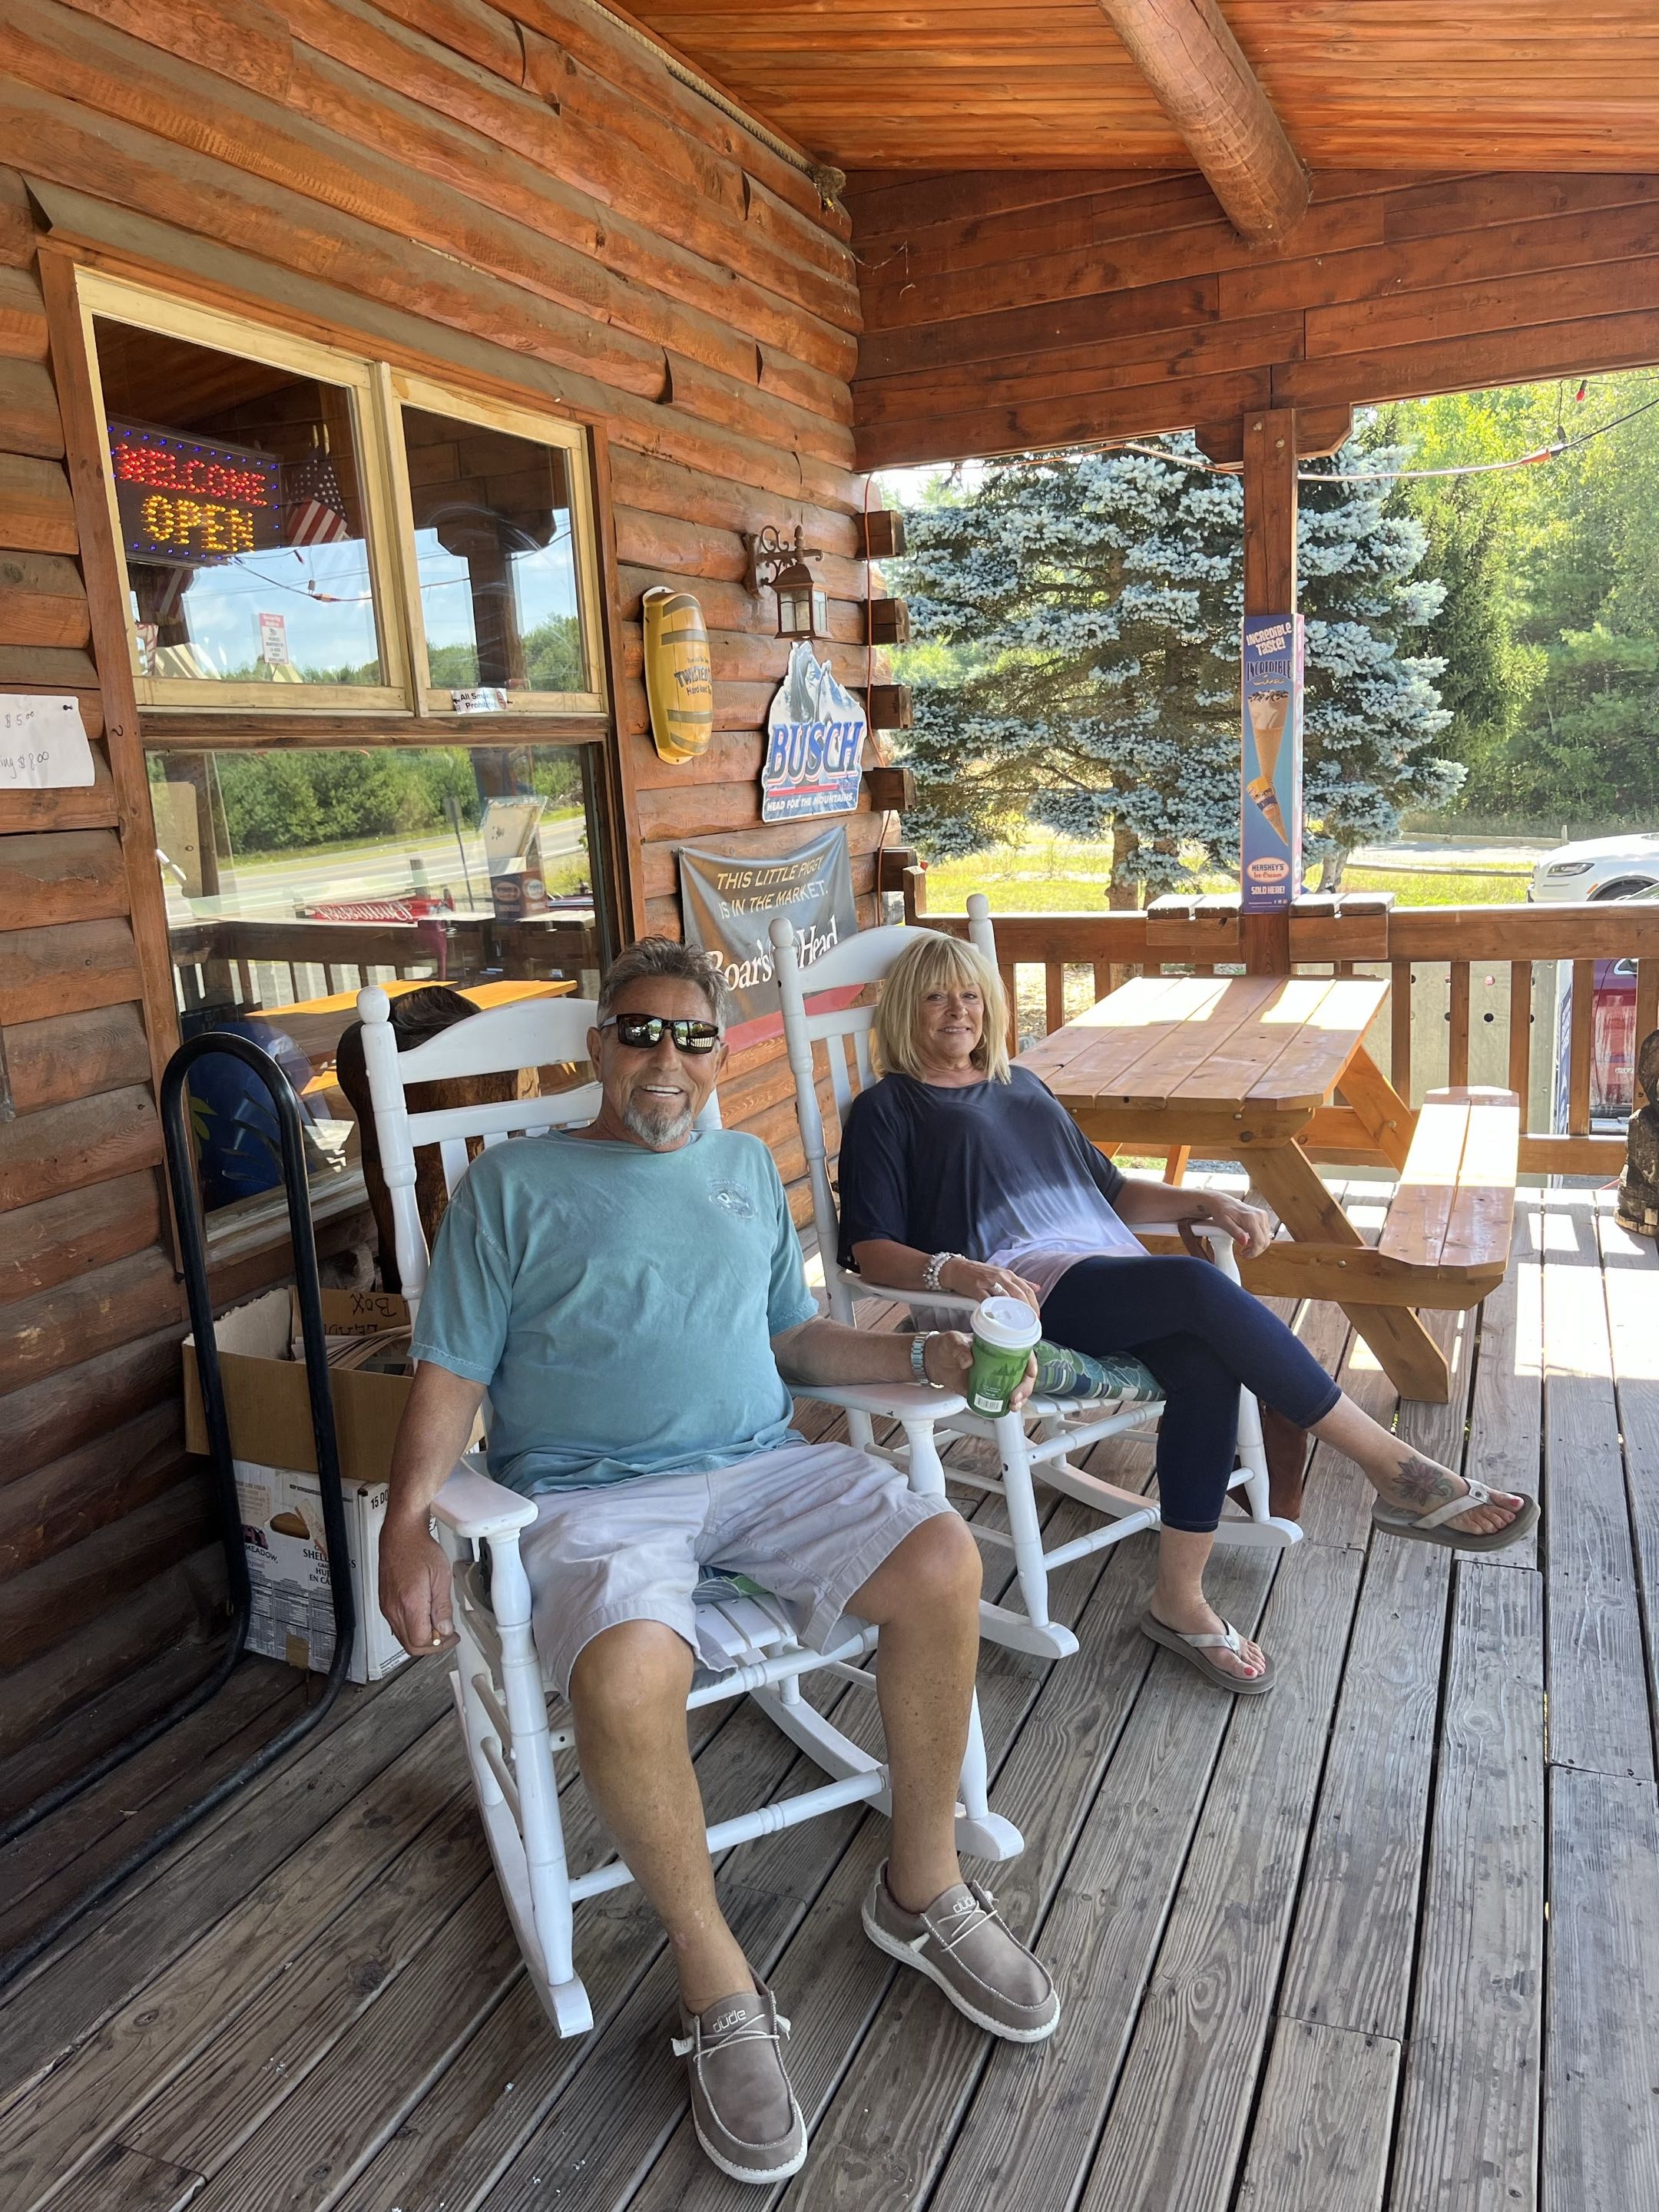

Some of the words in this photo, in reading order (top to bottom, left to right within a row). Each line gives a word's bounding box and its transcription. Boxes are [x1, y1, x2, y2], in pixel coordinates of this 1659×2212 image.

[118, 443, 267, 506] WELCOME
[143, 495, 253, 554] OPEN
[1247, 660, 1291, 682] INCREDIBLE
[768, 721, 864, 780] BUSCH
[767, 800, 785, 812] HEAD
[786, 798, 799, 809] FOR
[800, 796, 812, 806] THE
[813, 792, 853, 805] MOUNTAINS
[717, 872, 753, 890] THIS
[755, 864, 796, 887] LITTLE
[797, 853, 825, 879] PIGGY
[718, 901, 730, 920] IS
[731, 898, 747, 917] IN
[750, 893, 776, 913] THE
[776, 879, 829, 908] MARKET.
[1251, 886, 1267, 895] SOLD
[796, 915, 838, 969] Head
[371, 1496, 379, 1509] 15
[713, 2009, 747, 2032] dude
